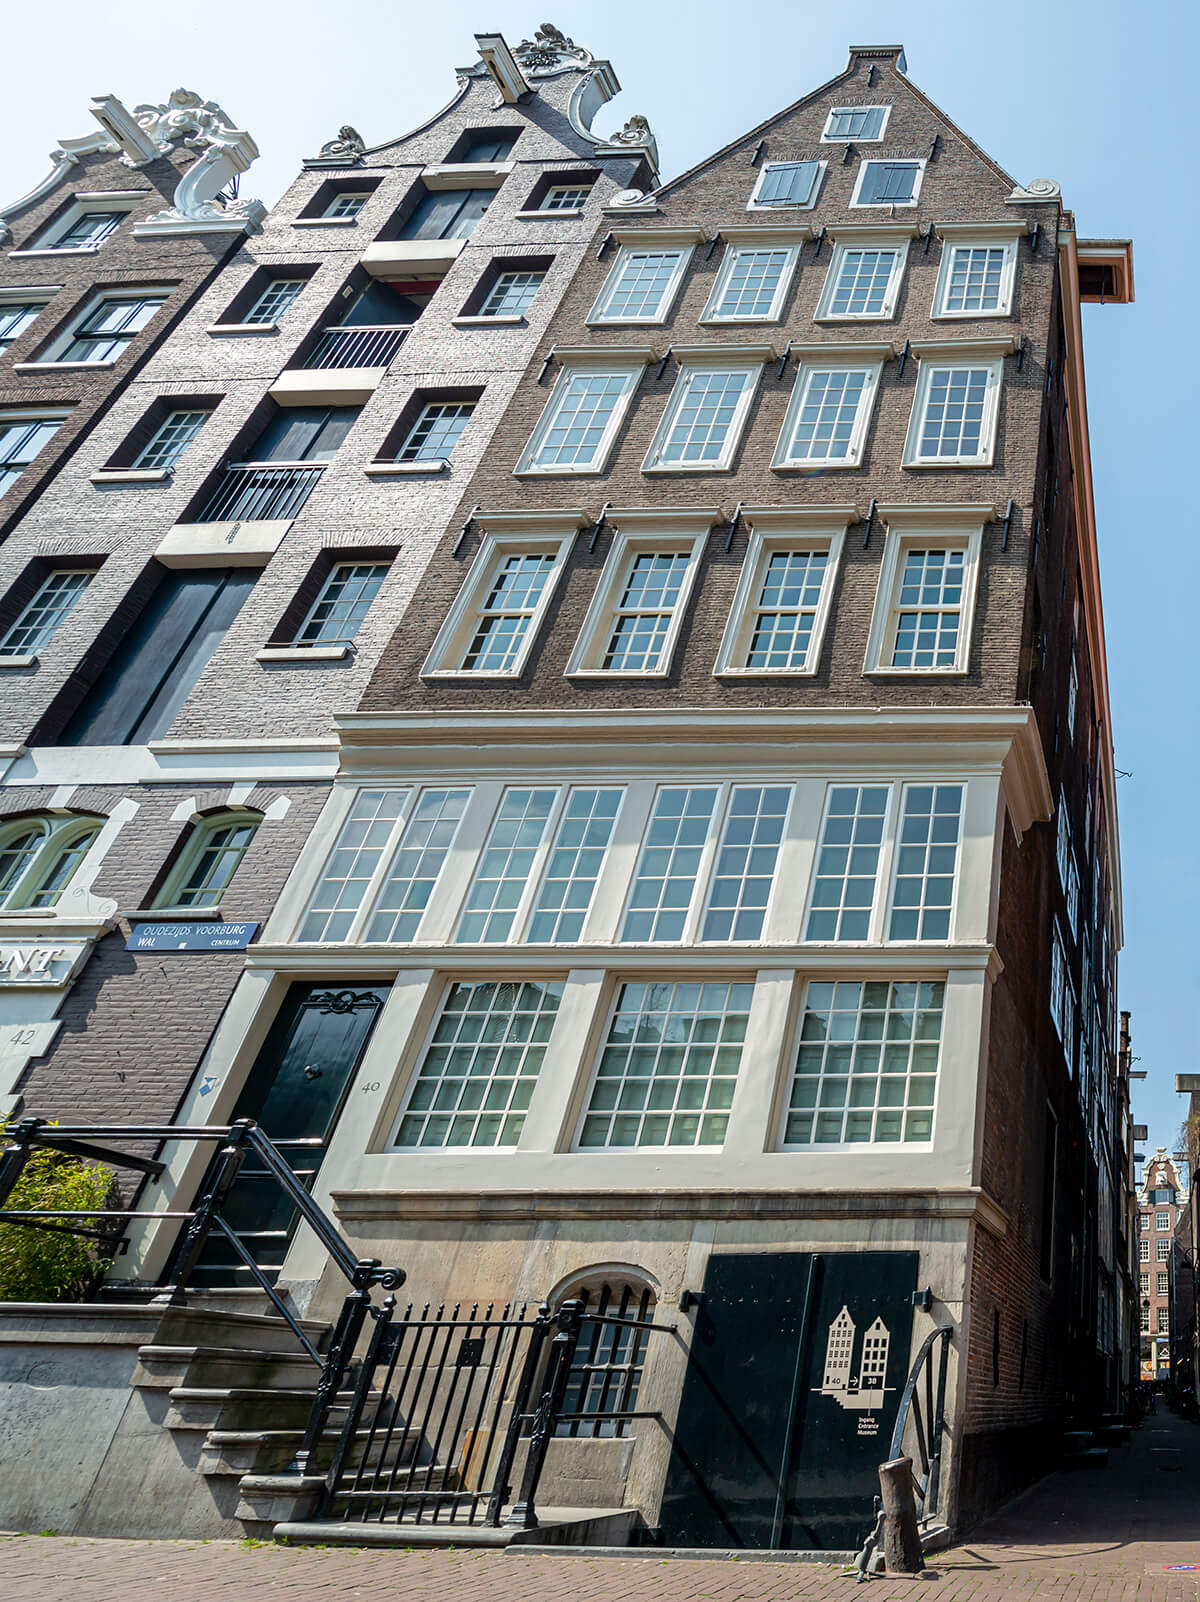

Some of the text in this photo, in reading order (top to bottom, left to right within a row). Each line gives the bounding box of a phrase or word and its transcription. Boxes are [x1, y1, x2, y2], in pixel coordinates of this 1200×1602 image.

[143, 925, 247, 937] OUDEZIJDS VOORBURG
[137, 937, 156, 947] WAL
[0, 949, 65, 973] NT
[10, 1030, 36, 1046] 42
[361, 1081, 381, 1094] 40
